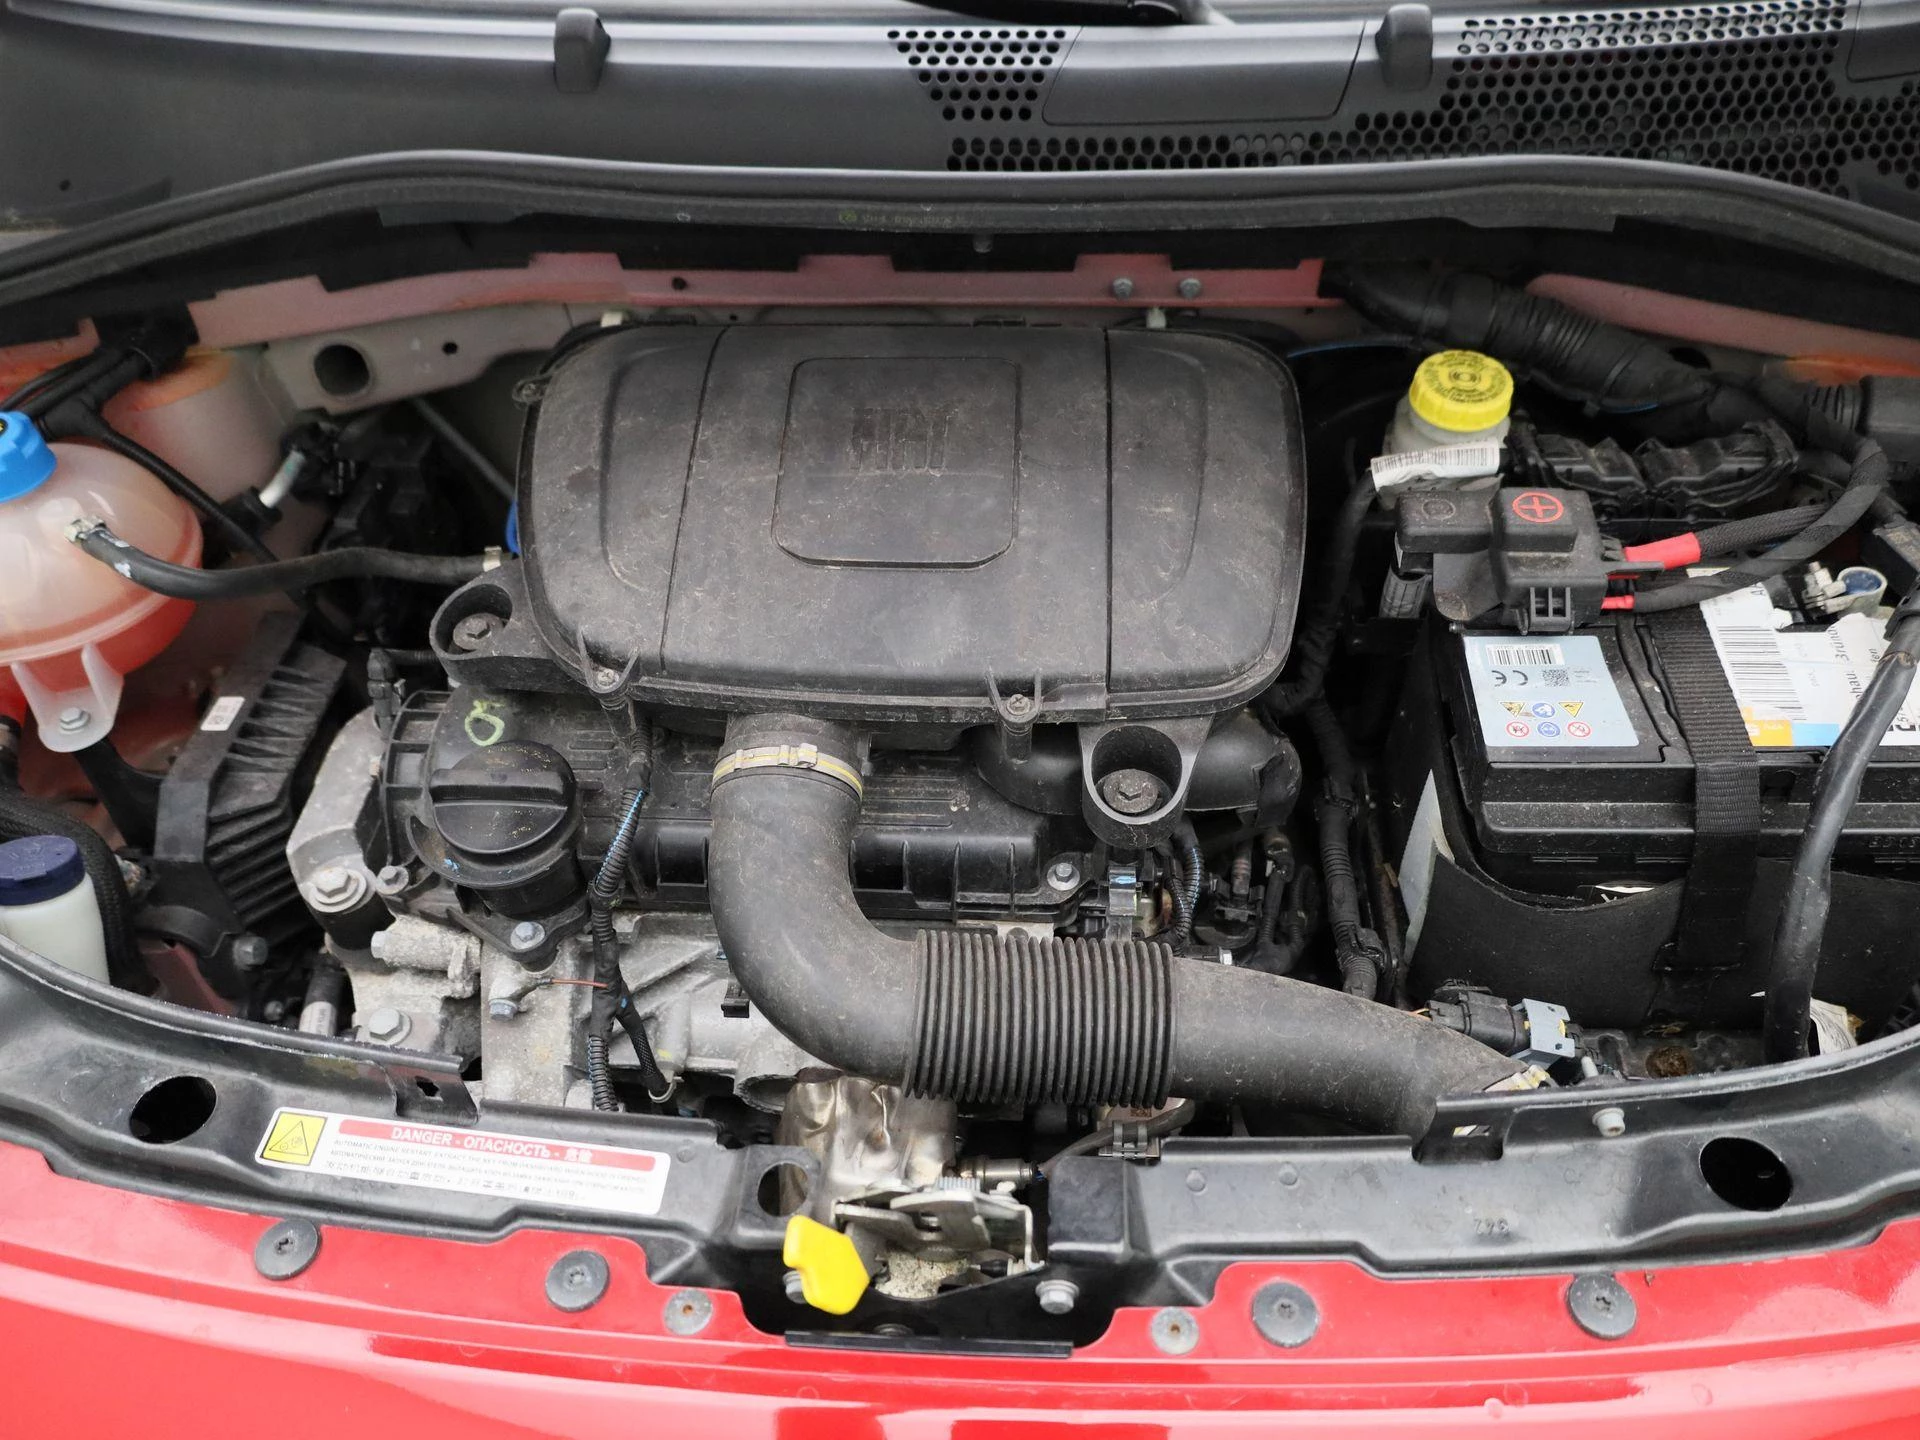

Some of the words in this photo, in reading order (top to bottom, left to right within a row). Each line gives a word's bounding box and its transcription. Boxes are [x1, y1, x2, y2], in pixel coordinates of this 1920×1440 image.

[850, 406, 958, 473] FIAT
[391, 1127, 453, 1145] DANGER
[463, 1136, 551, 1158] ОПАСНОСТЬ
